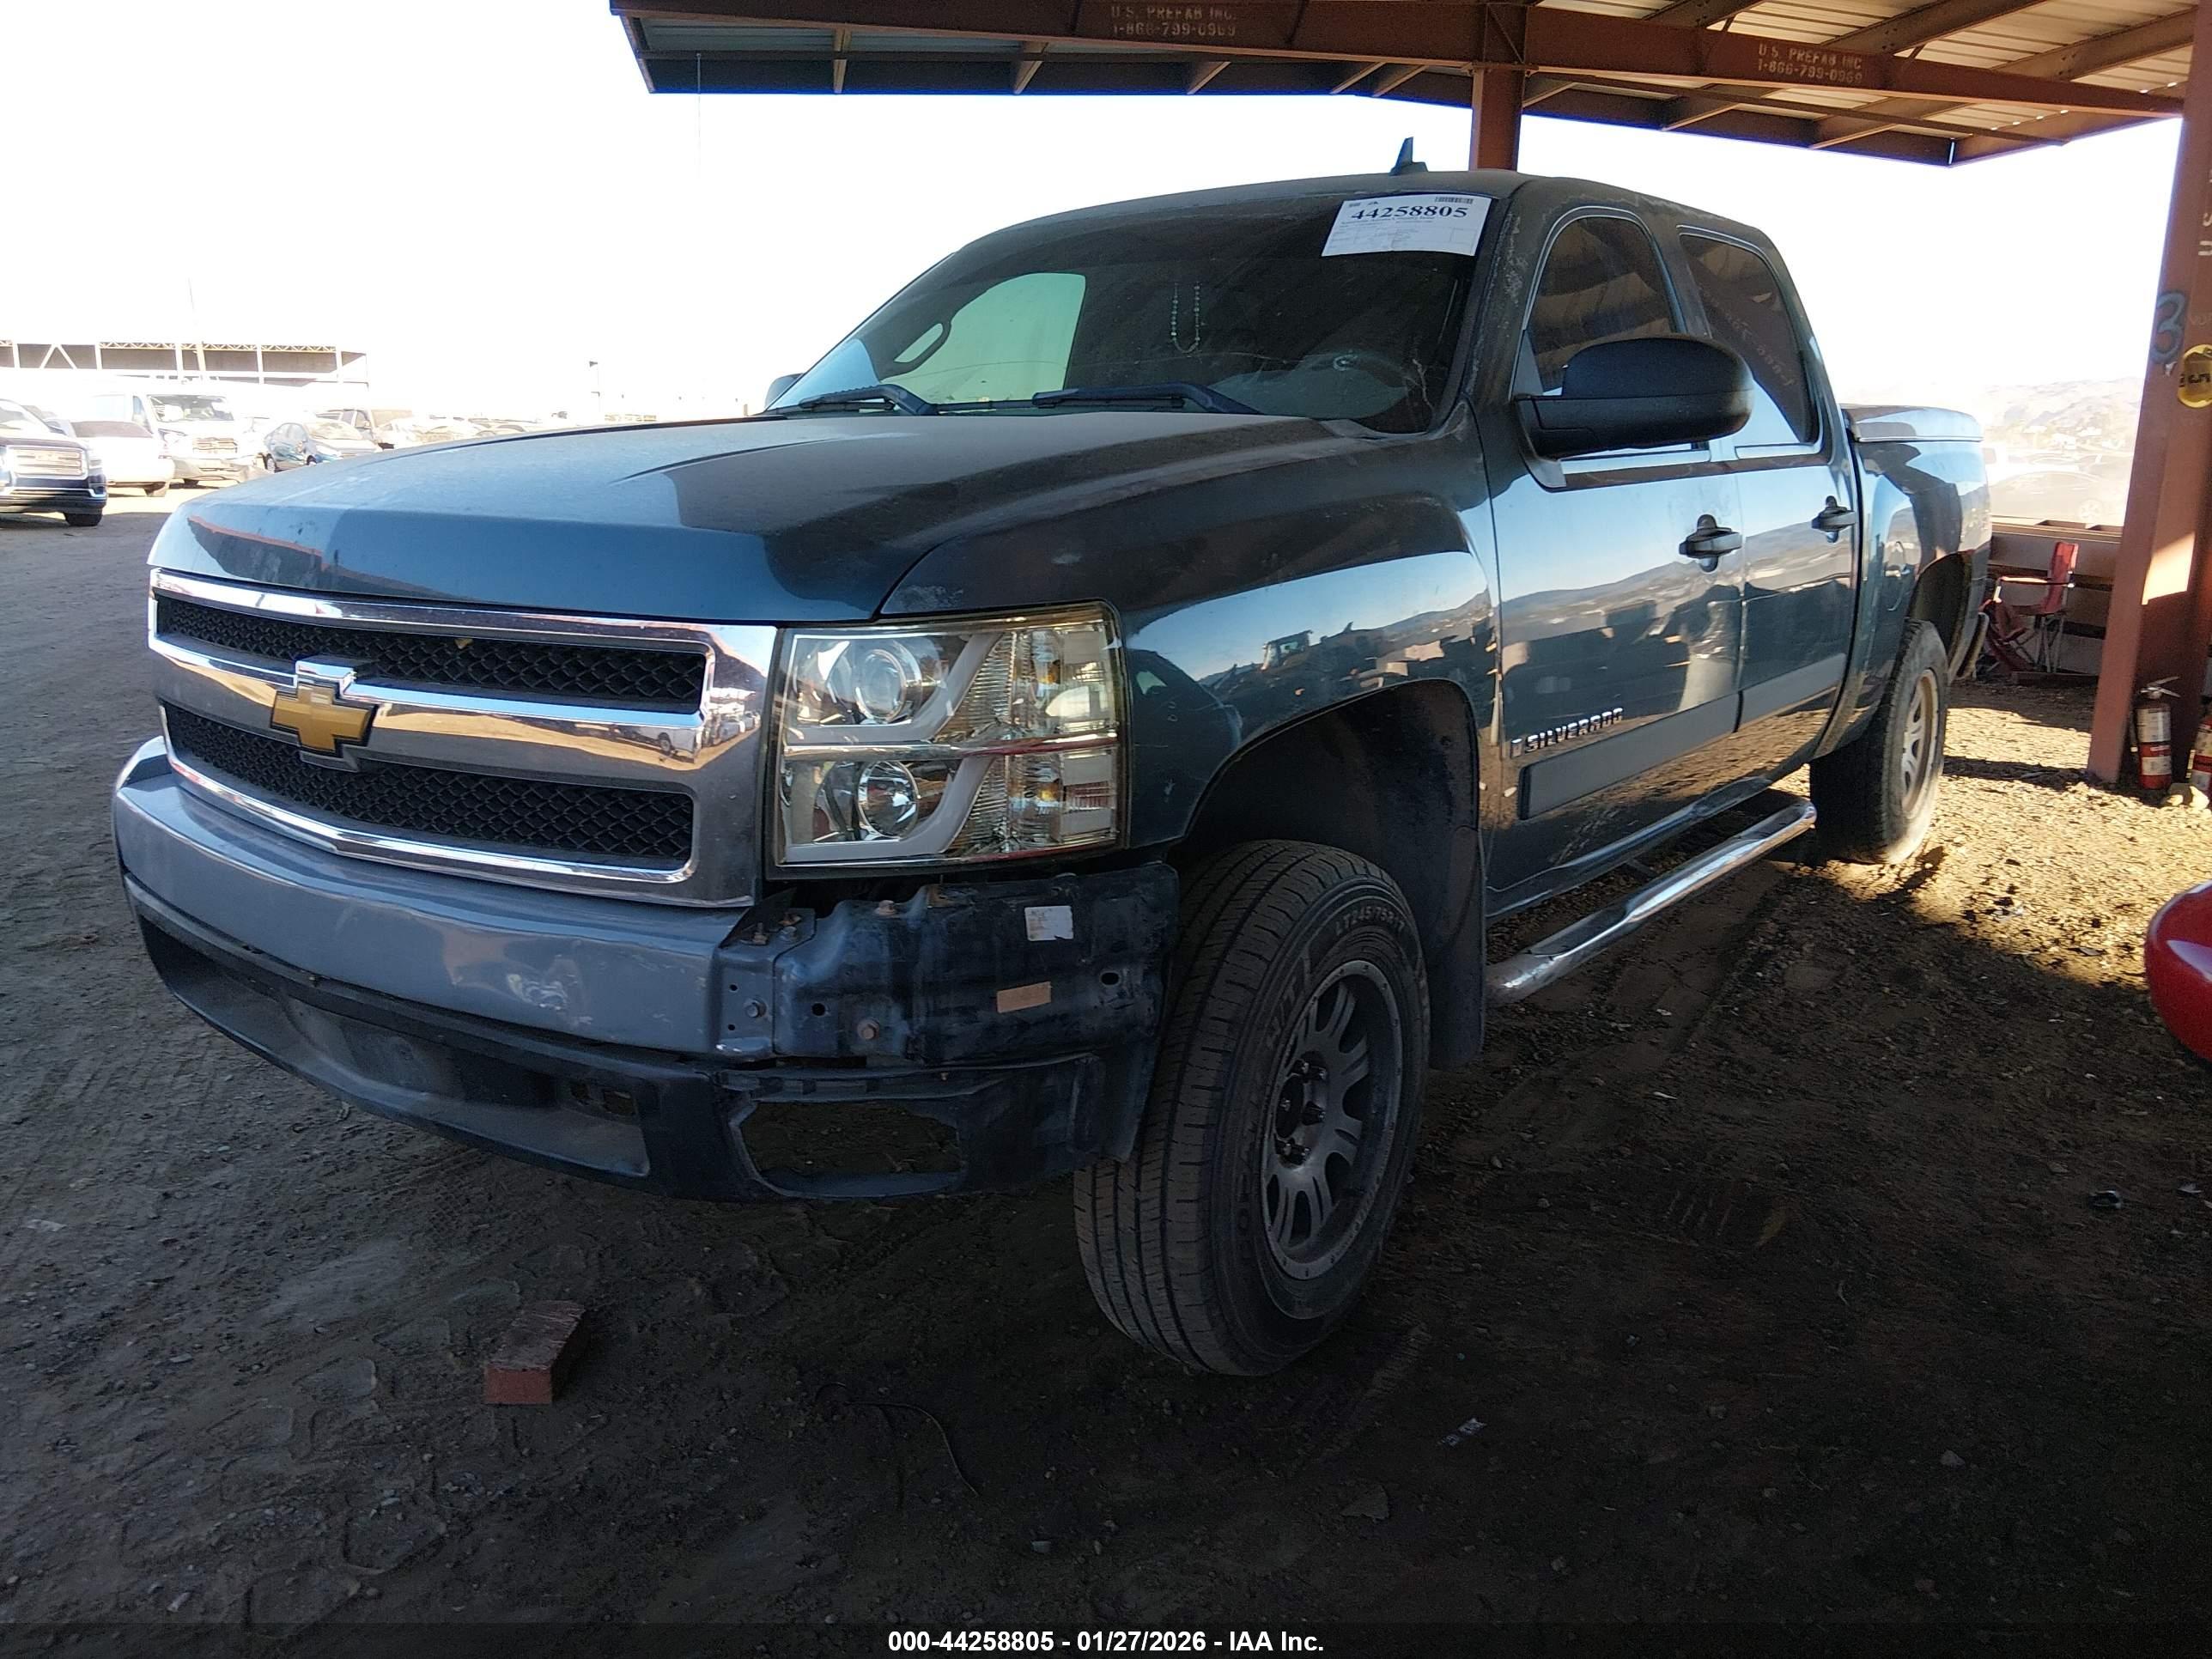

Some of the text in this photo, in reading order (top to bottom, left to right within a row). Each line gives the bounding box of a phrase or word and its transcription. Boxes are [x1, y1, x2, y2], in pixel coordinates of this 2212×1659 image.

[1789, 48, 1836, 65] PREFAB
[1351, 205, 1469, 219] 44258805
[1525, 708, 1623, 752] SILVERADO
